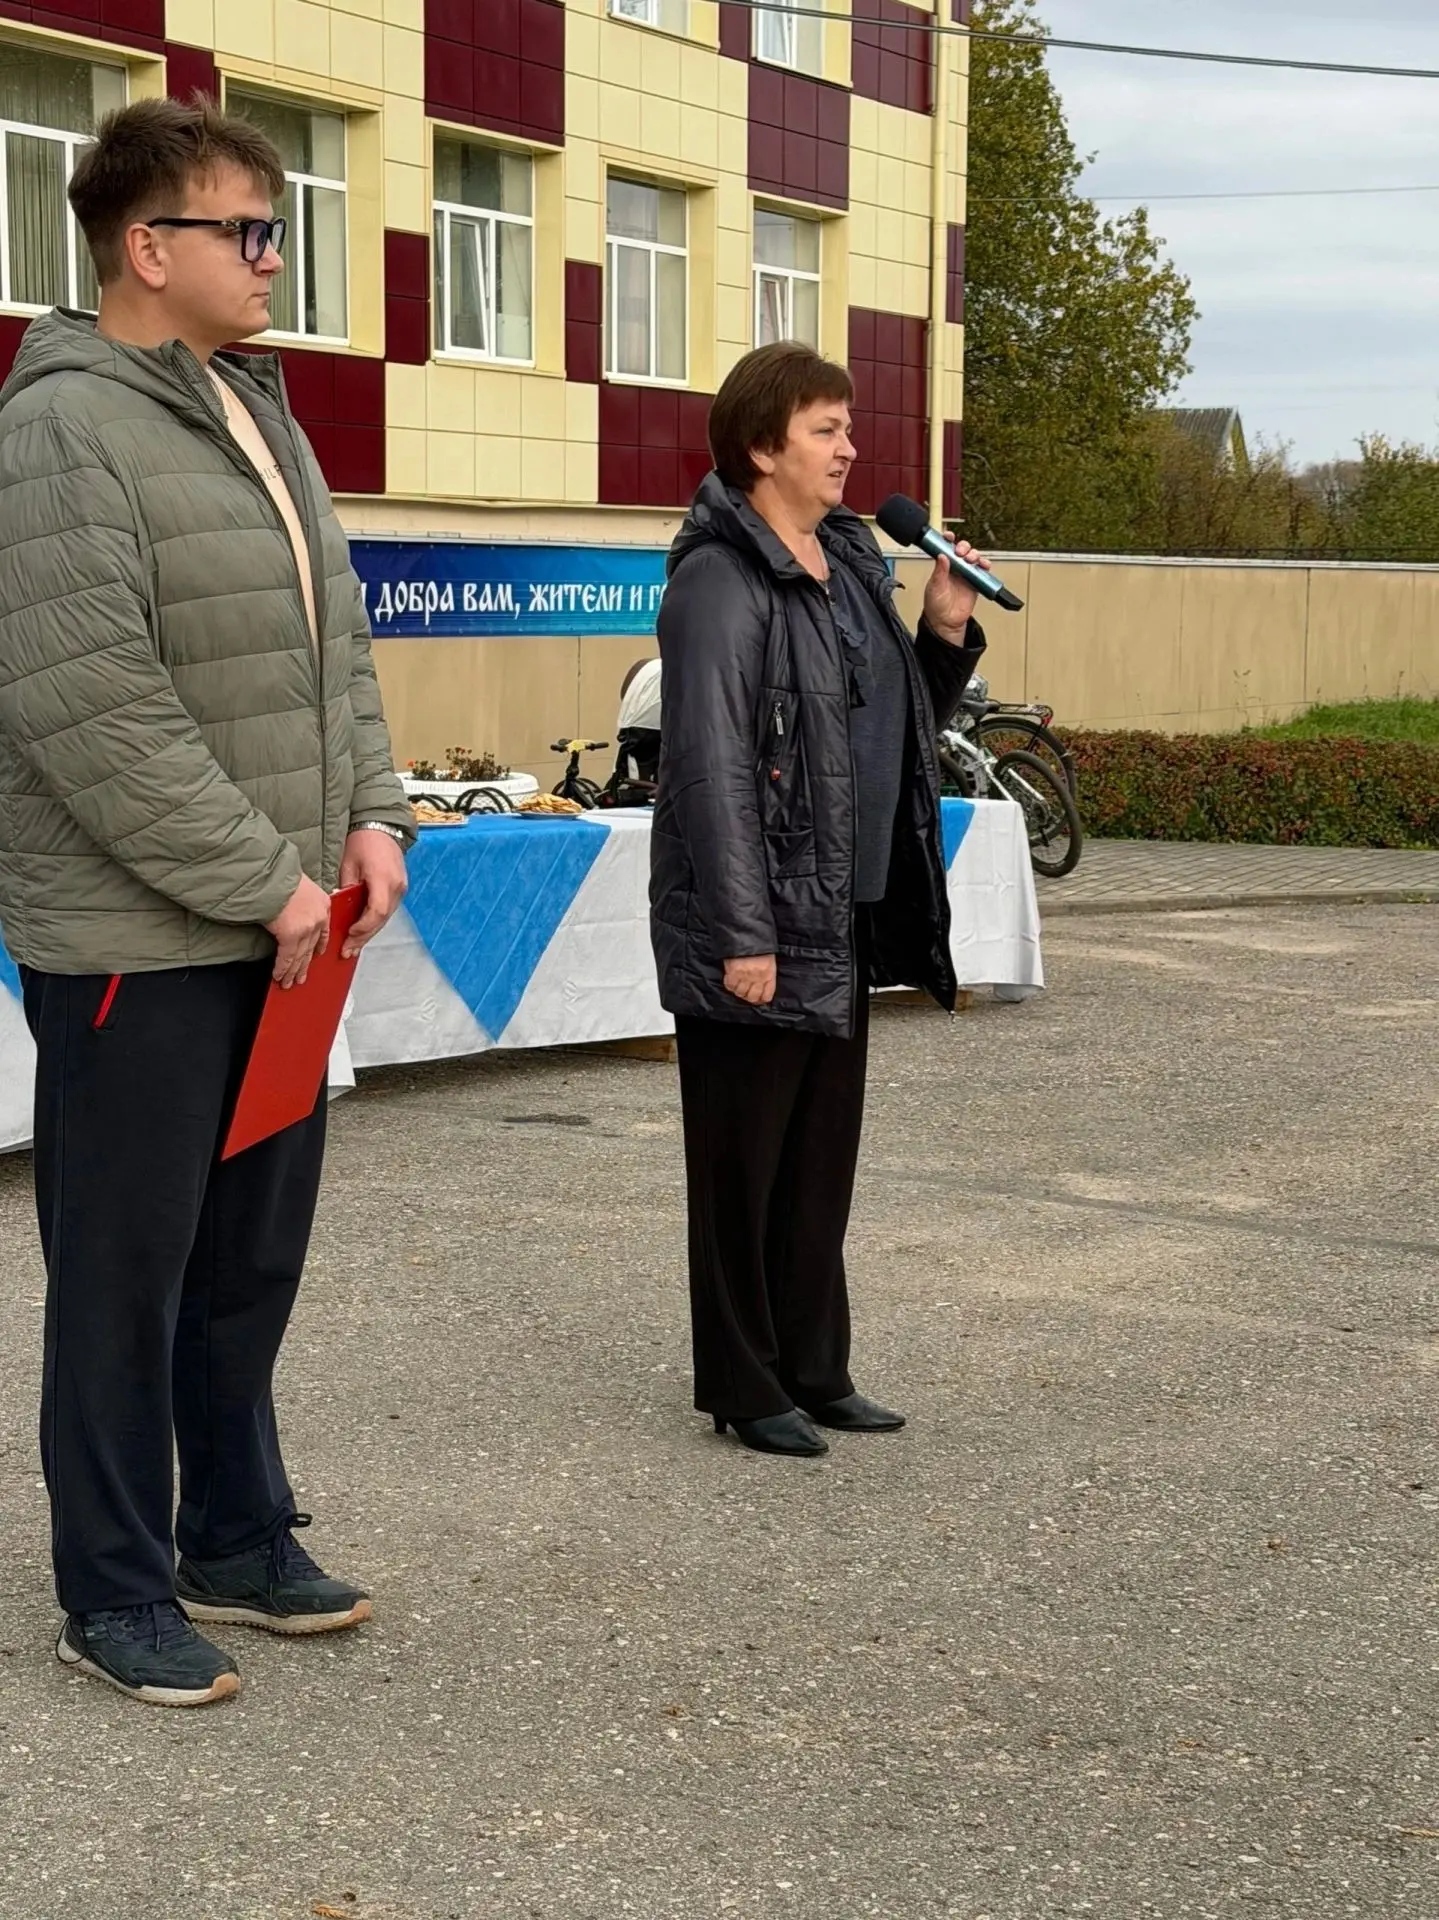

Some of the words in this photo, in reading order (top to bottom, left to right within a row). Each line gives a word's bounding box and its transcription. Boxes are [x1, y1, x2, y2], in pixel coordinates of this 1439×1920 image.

[374, 581, 454, 626] ДОБРА
[463, 583, 520, 620] ВАМ,
[528, 583, 622, 612] ЖИТЕЛИ
[629, 584, 643, 611] И
